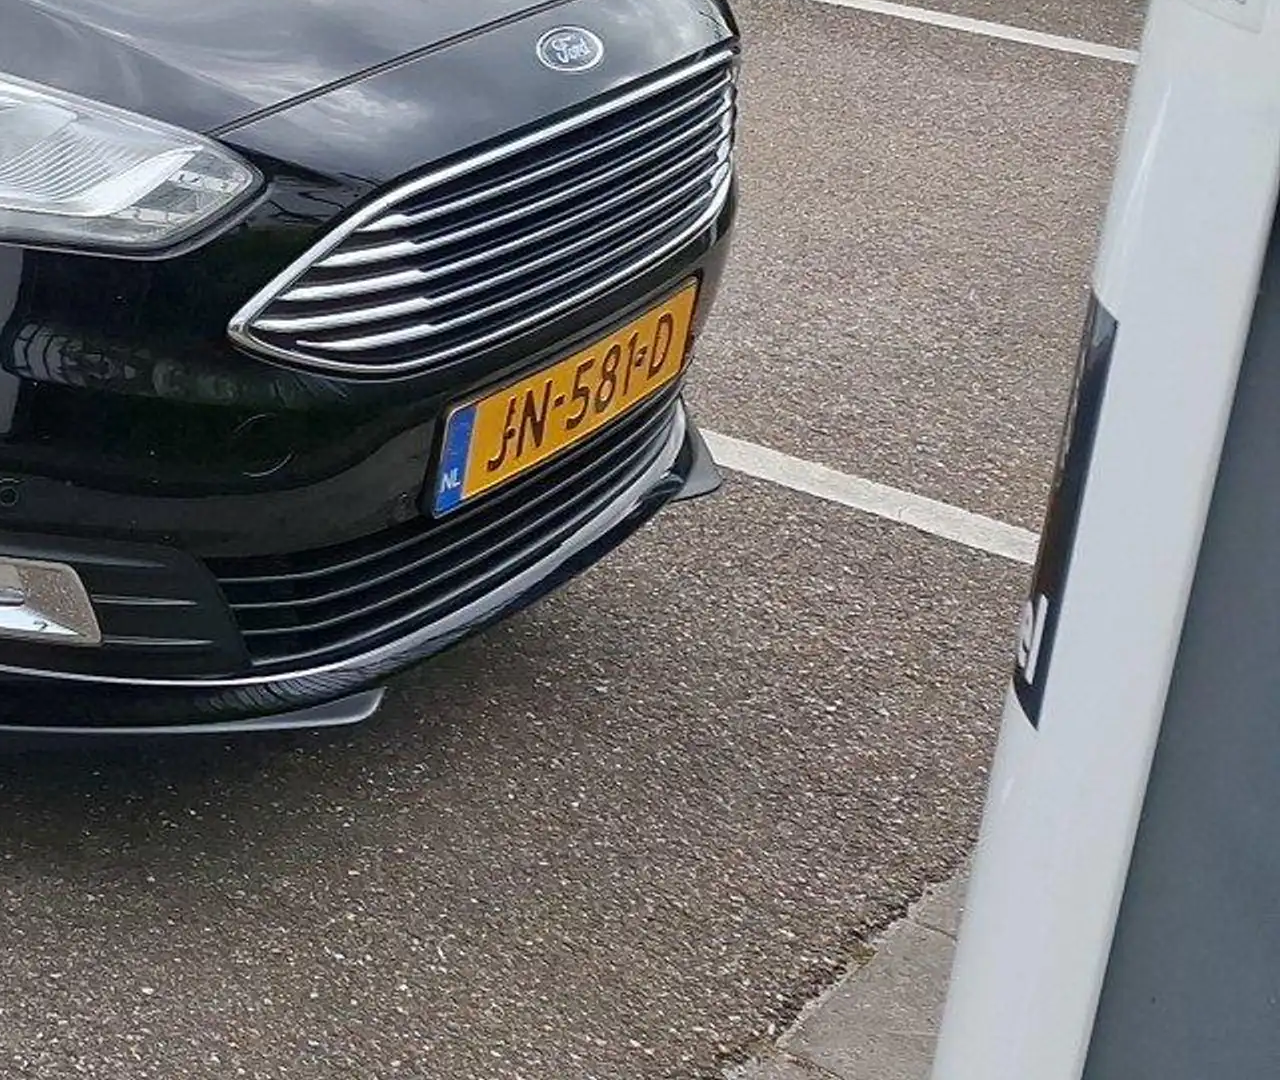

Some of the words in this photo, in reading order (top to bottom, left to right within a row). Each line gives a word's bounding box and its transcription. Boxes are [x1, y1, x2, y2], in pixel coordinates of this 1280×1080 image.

[550, 34, 592, 64] Ford
[486, 312, 675, 472] JN-581-D
[440, 467, 462, 493] NL
